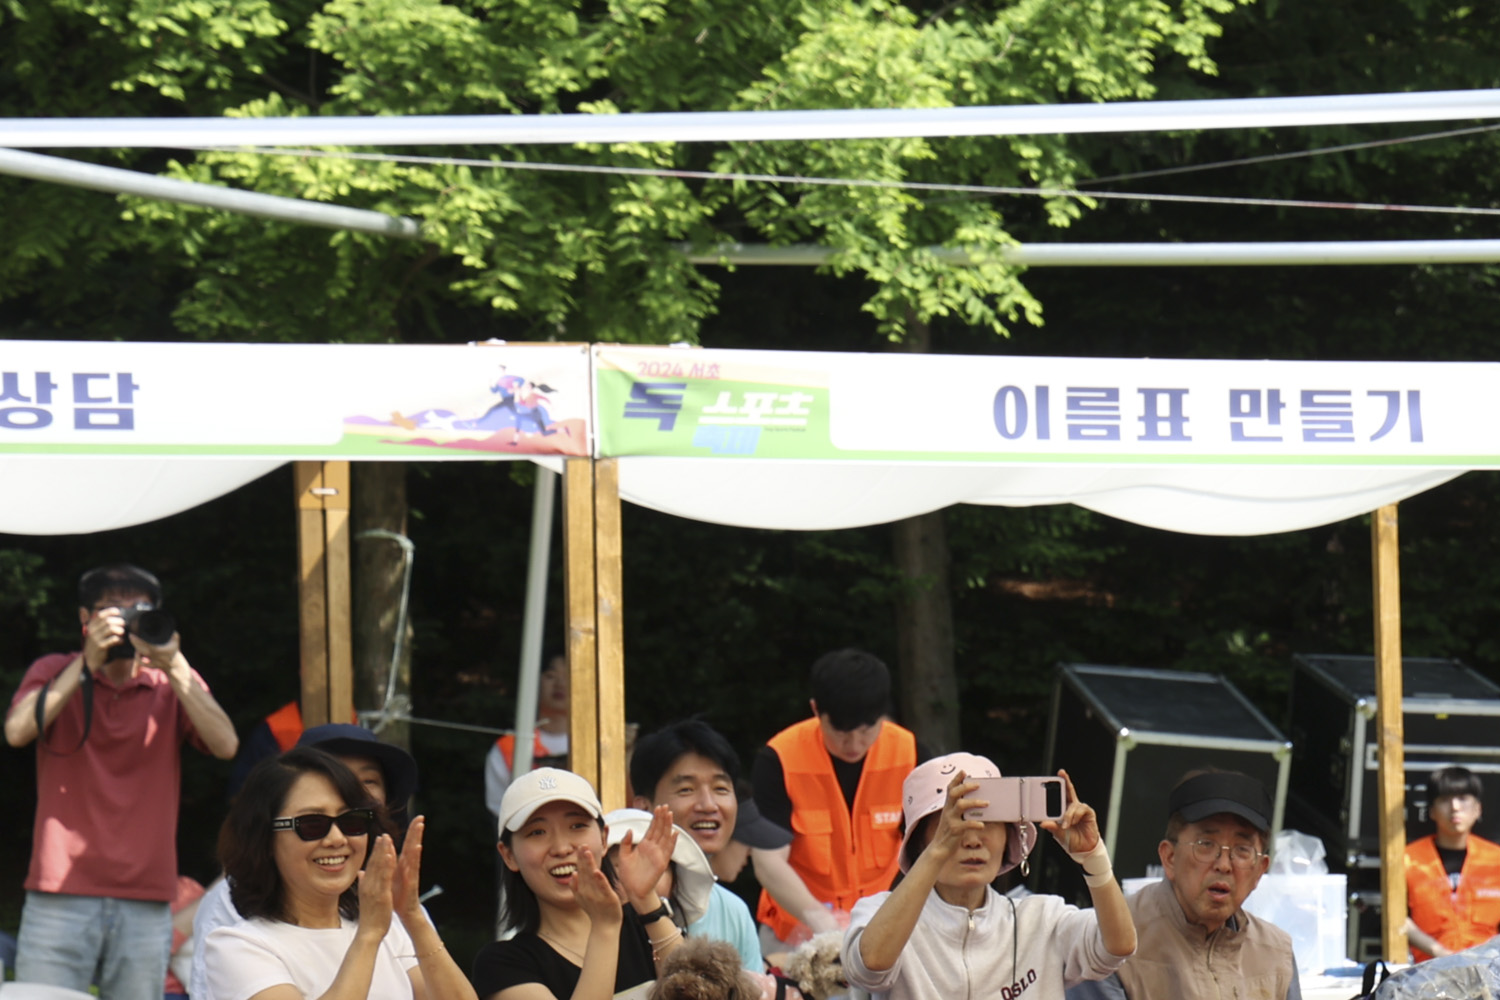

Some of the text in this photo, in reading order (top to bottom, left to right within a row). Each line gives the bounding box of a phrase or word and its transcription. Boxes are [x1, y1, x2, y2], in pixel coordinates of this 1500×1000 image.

[637, 360, 721, 380] 2024 서초
[0, 371, 140, 431] 상담
[622, 381, 814, 432] 독 스포츠
[992, 384, 1425, 445] 이름표 만들기
